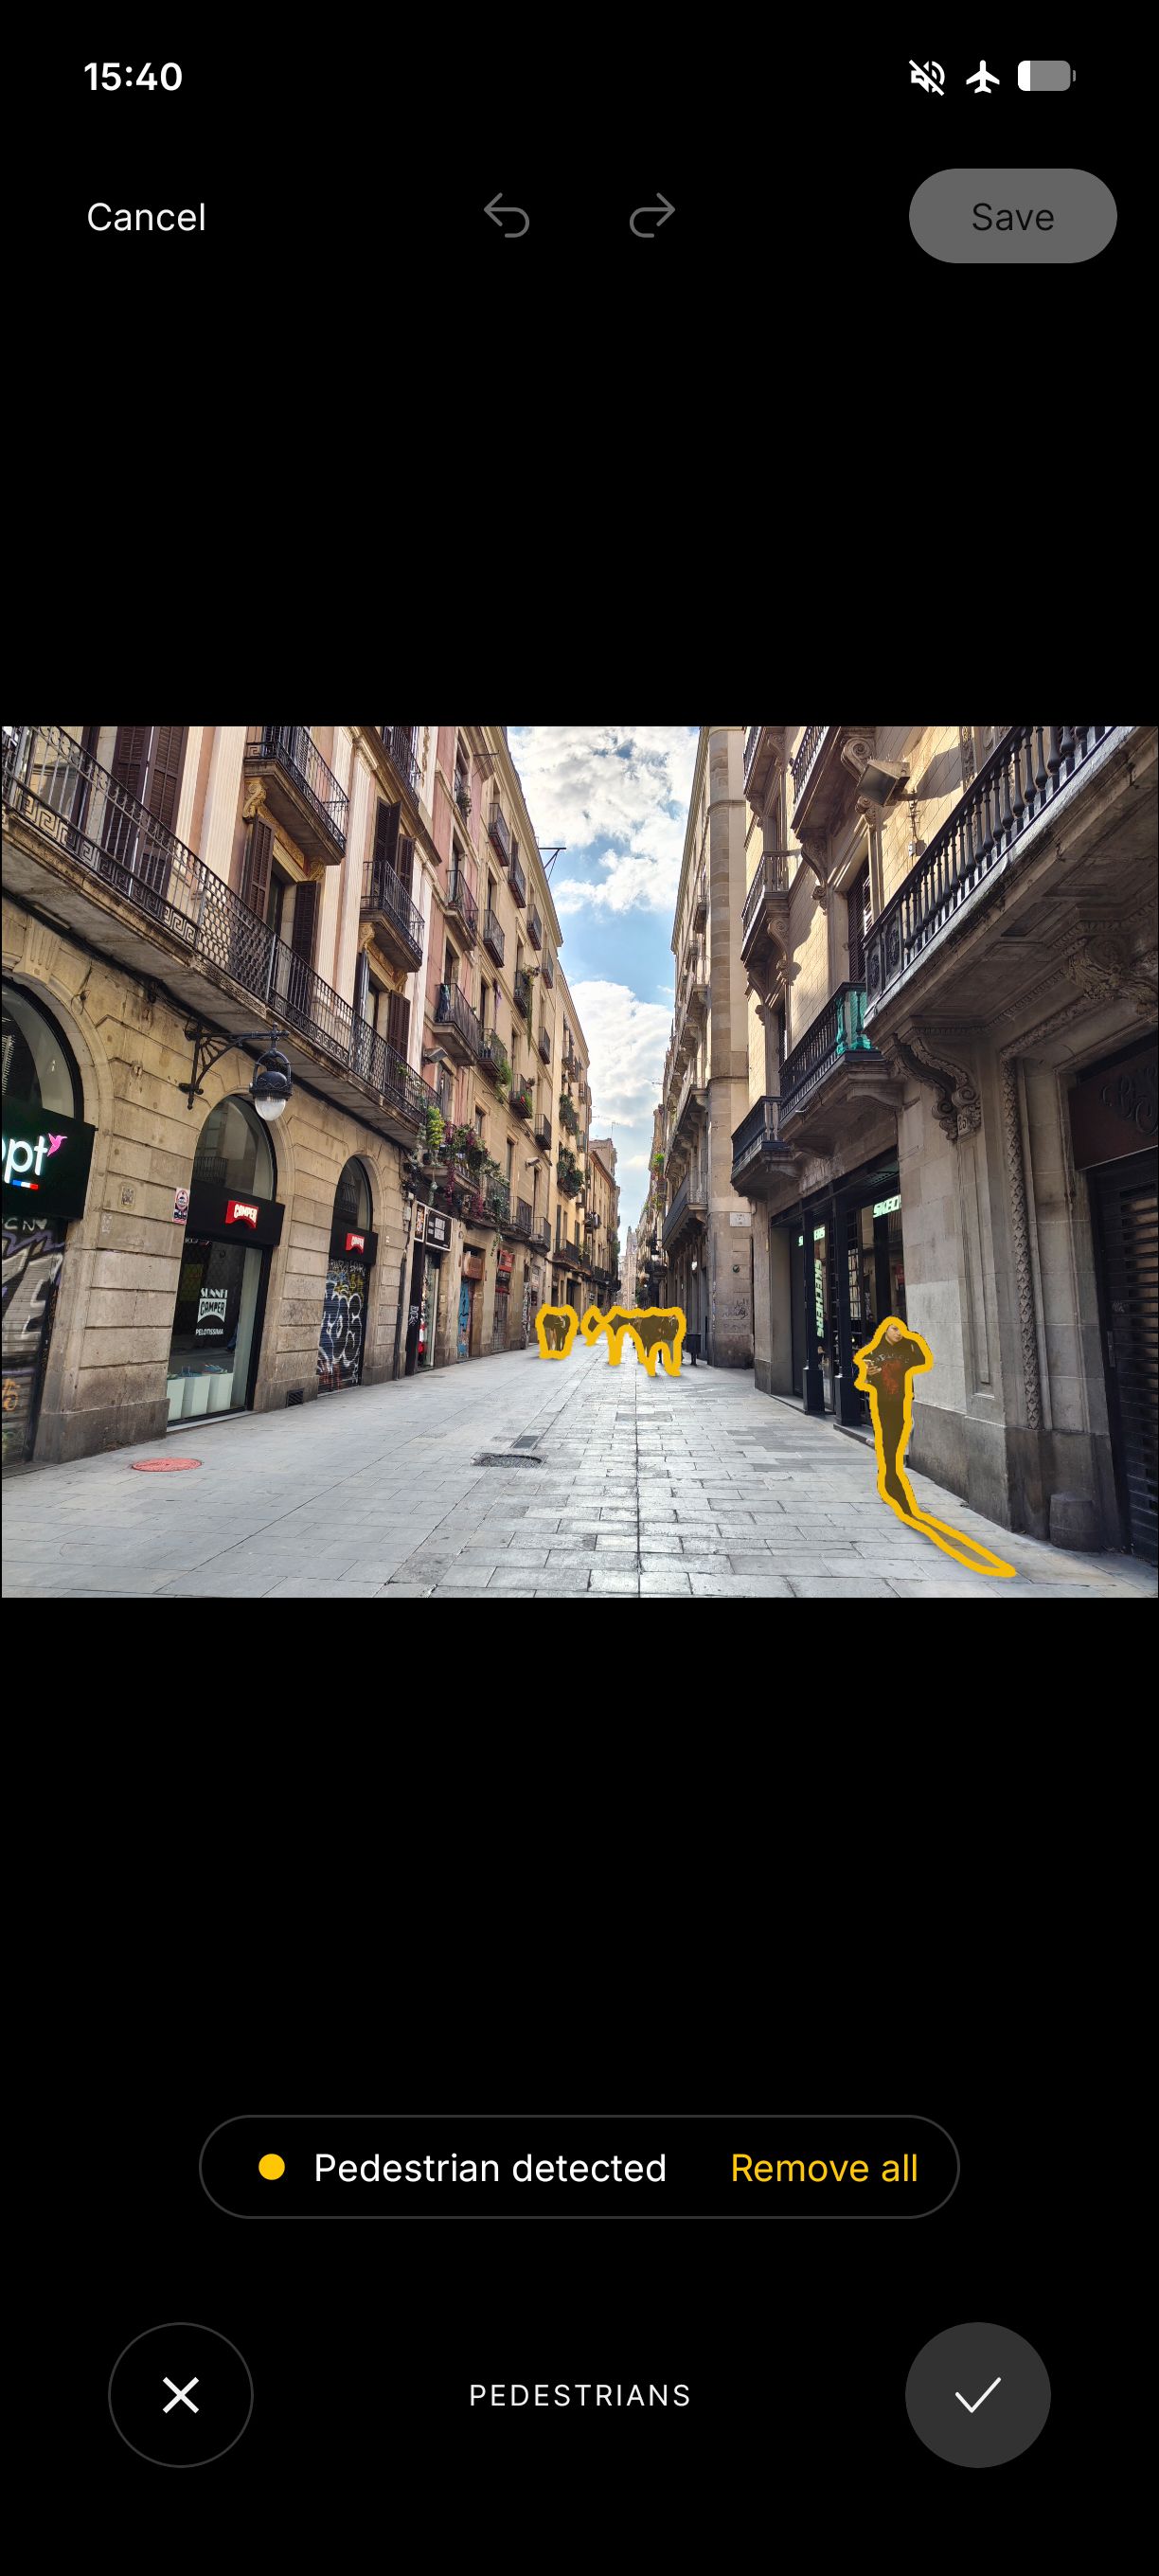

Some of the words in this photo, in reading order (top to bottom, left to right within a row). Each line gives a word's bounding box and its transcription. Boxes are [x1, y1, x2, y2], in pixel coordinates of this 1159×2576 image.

[2, 1135, 47, 1184] pt
[234, 1204, 258, 1224] CAMPER
[200, 1301, 225, 1317] CAMPER
